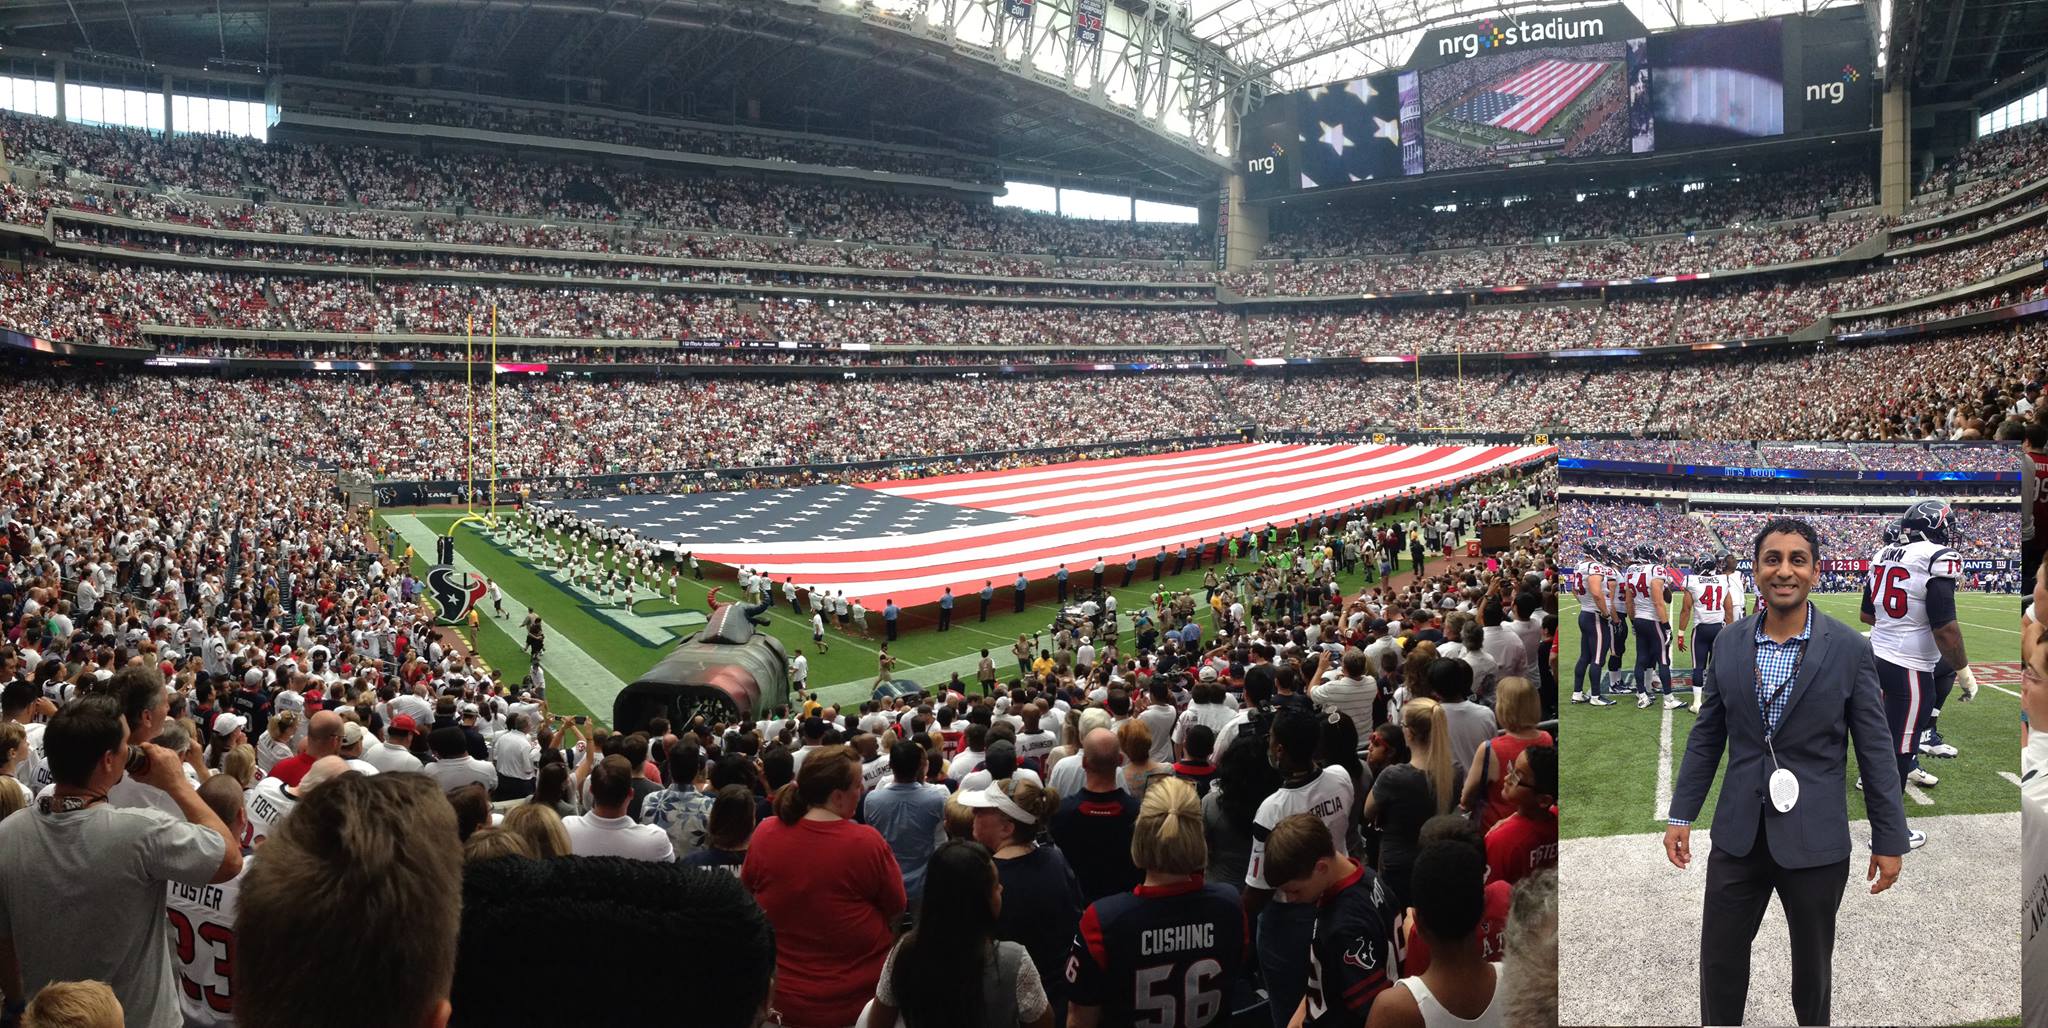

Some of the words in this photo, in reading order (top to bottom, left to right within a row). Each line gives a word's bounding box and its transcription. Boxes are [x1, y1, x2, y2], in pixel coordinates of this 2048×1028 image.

[1011, 4, 1025, 17] 2011
[1082, 30, 1096, 42] 2012
[1439, 34, 1479, 58] nrg
[1505, 17, 1604, 46] stadium
[1806, 81, 1845, 104] nrg
[1248, 156, 1275, 174] nrg
[1750, 467, 1777, 478] GOOD
[1656, 567, 1667, 576] 54
[1830, 560, 1860, 571] 12:19
[1996, 560, 2007, 570] ny
[1699, 585, 1723, 611] 41
[1871, 564, 1911, 620] 76
[1141, 922, 1214, 956] CUSHING
[1136, 958, 1223, 1028] 56
